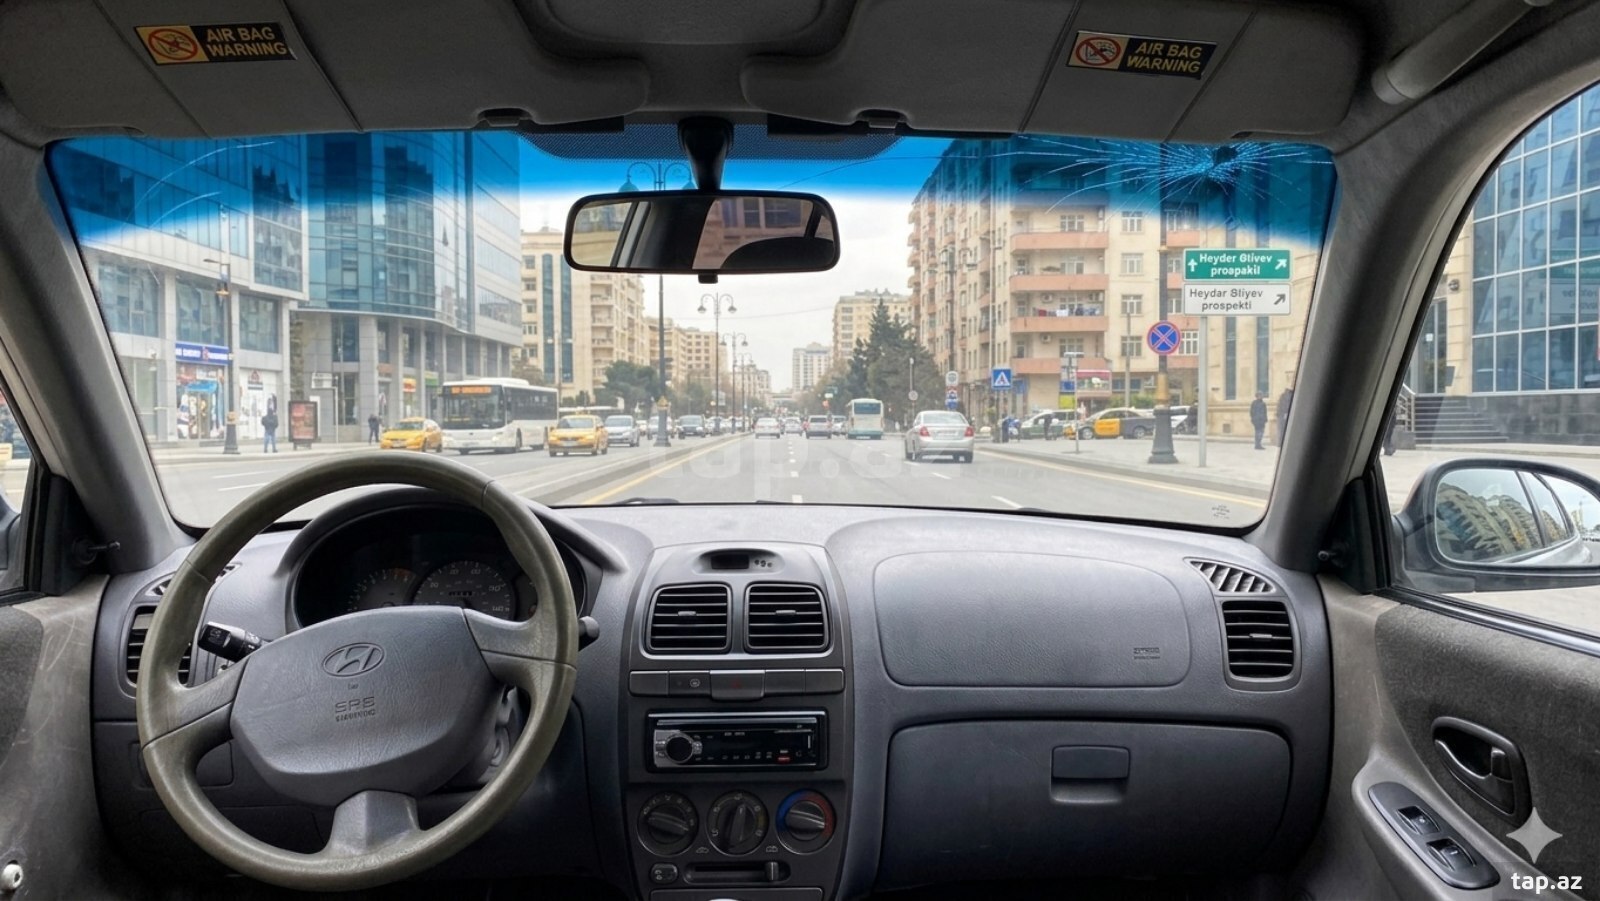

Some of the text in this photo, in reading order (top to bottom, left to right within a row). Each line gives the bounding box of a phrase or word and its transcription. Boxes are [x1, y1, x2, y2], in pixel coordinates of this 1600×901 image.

[206, 26, 275, 42] AIR BAG
[206, 42, 288, 57] WARNING
[1135, 42, 1202, 59] AIR BAG
[1126, 55, 1201, 73] WARNING
